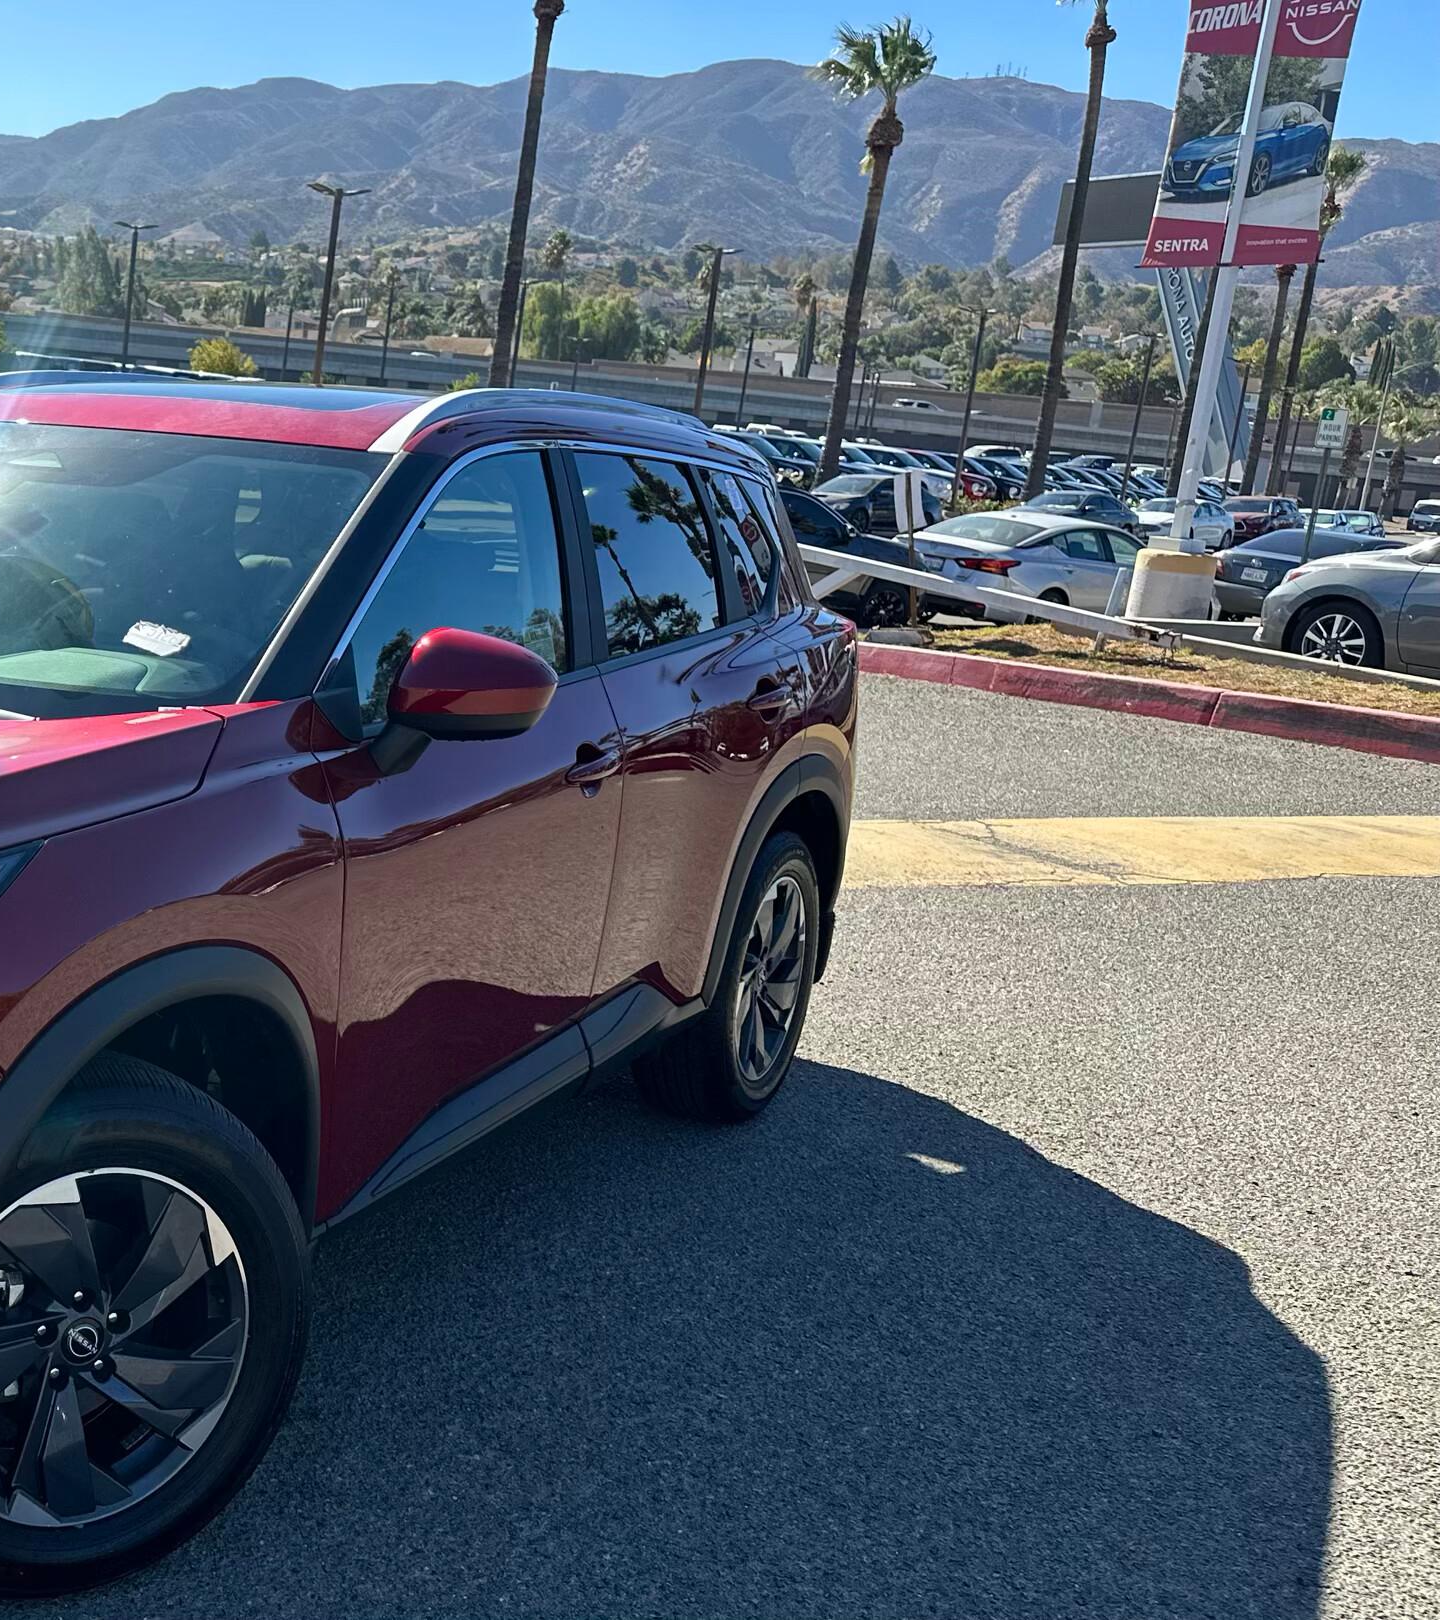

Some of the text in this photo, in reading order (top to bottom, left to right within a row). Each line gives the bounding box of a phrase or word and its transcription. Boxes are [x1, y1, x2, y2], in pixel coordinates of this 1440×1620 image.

[1189, 1, 1263, 34] CORONA
[1285, 0, 1360, 19] NISSAN
[1153, 238, 1209, 252] SENTRA
[1167, 266, 1187, 314] RONA
[1325, 410, 1333, 420] 2
[68, 1328, 97, 1354] NISSAN
